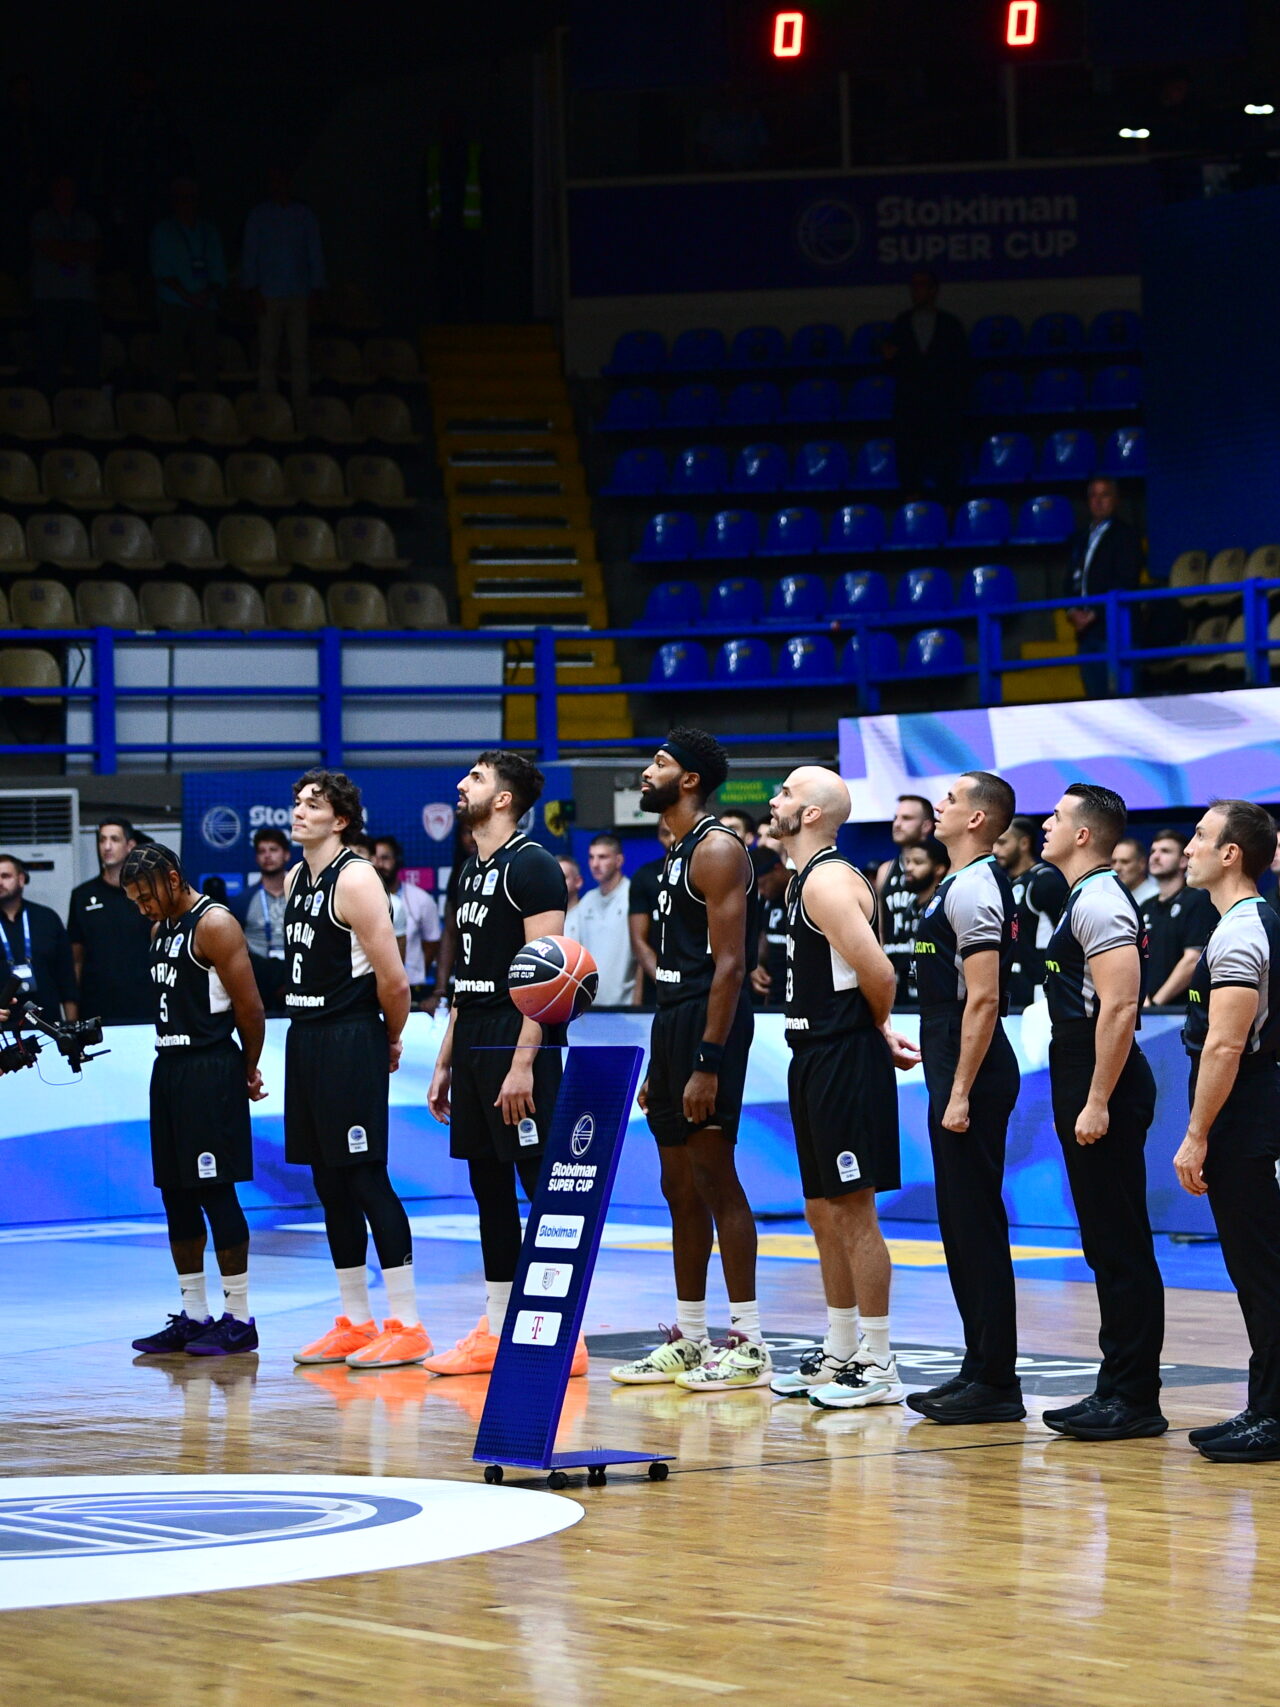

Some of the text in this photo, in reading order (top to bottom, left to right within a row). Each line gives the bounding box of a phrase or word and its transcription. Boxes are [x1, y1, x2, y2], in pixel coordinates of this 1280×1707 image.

[773, 12, 804, 57] 0
[1006, 0, 1038, 46] 0
[876, 194, 1079, 229] Stoiximan
[877, 229, 1079, 264] SUPER CUP
[456, 901, 489, 929] PAOK
[286, 921, 315, 949] PAOK
[462, 933, 472, 965] 9
[292, 952, 303, 985] 6
[160, 992, 169, 1023] 5
[548, 1178, 594, 1192] SUPER CUP
[551, 1161, 597, 1178] Stoiximan
[539, 1225, 577, 1238] Stoiximan
